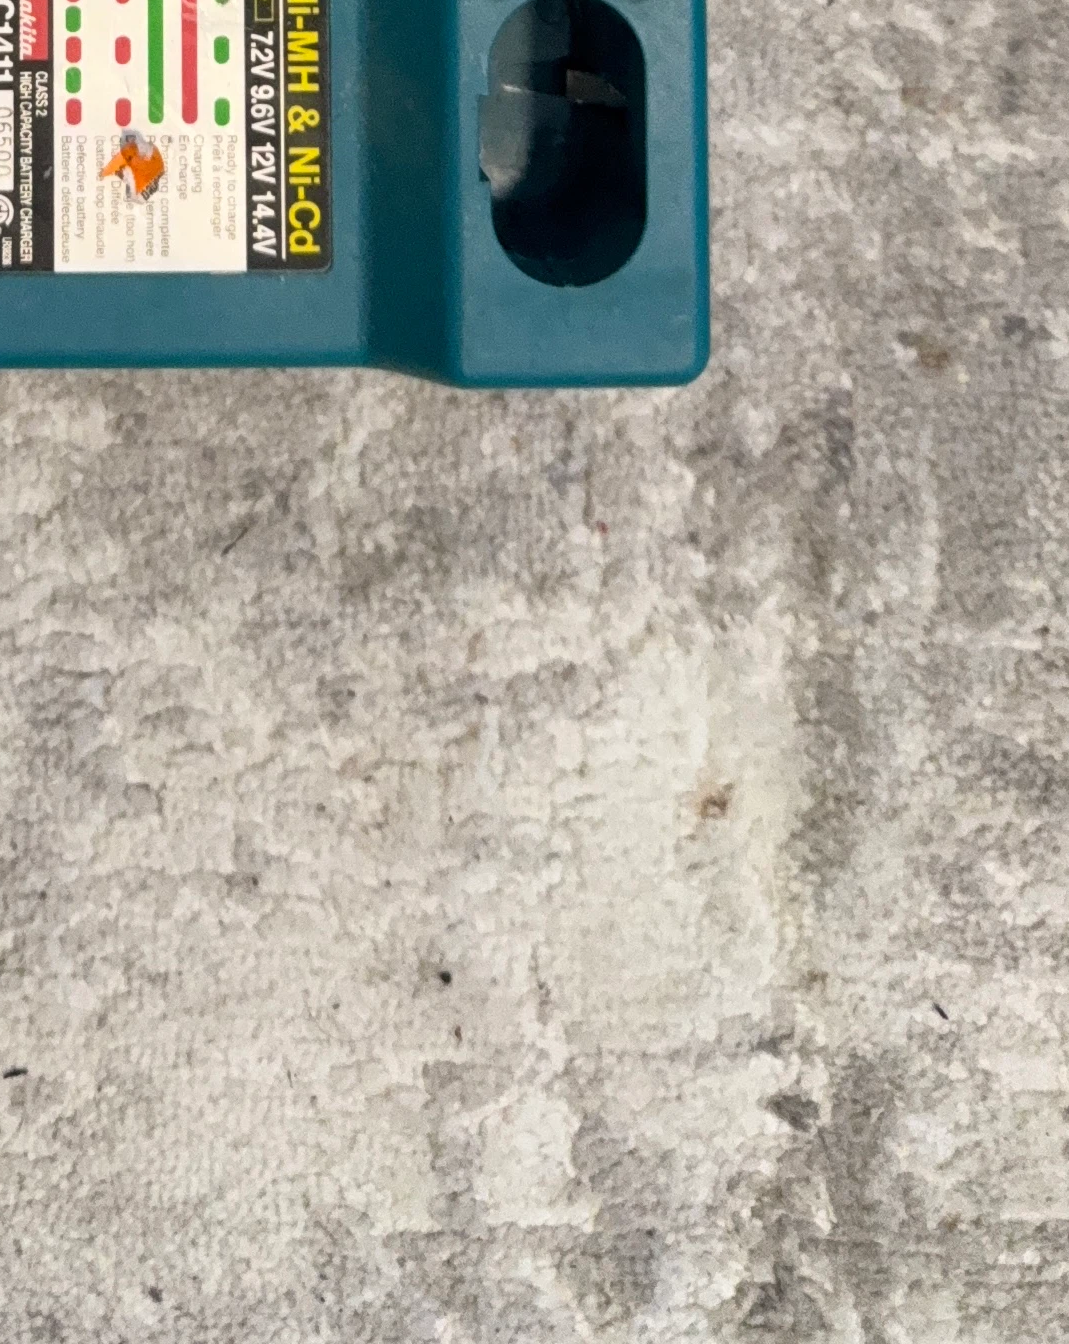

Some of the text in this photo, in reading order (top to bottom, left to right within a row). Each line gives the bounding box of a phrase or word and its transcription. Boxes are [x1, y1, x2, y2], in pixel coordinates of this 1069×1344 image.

[35, 71, 48, 117] CLASS 2
[287, 105, 319, 134] &
[19, 72, 32, 262] HIGH CAPACITY BATTERY CHARGER
[175, 136, 189, 200] En charge
[190, 135, 204, 193] Charging
[211, 135, 223, 161] Prêt
[251, 30, 277, 256] 7.2V 9.6V 12V 14.4V
[61, 136, 72, 264] Batterie défectueuse
[74, 135, 87, 240] Defective battery
[93, 186, 105, 208] trop
[209, 177, 223, 239] recharger
[224, 135, 237, 240] Ready to charge
[288, 146, 321, 254] Ni-Cd
[94, 212, 106, 258] chaude)
[158, 198, 171, 257] complete
